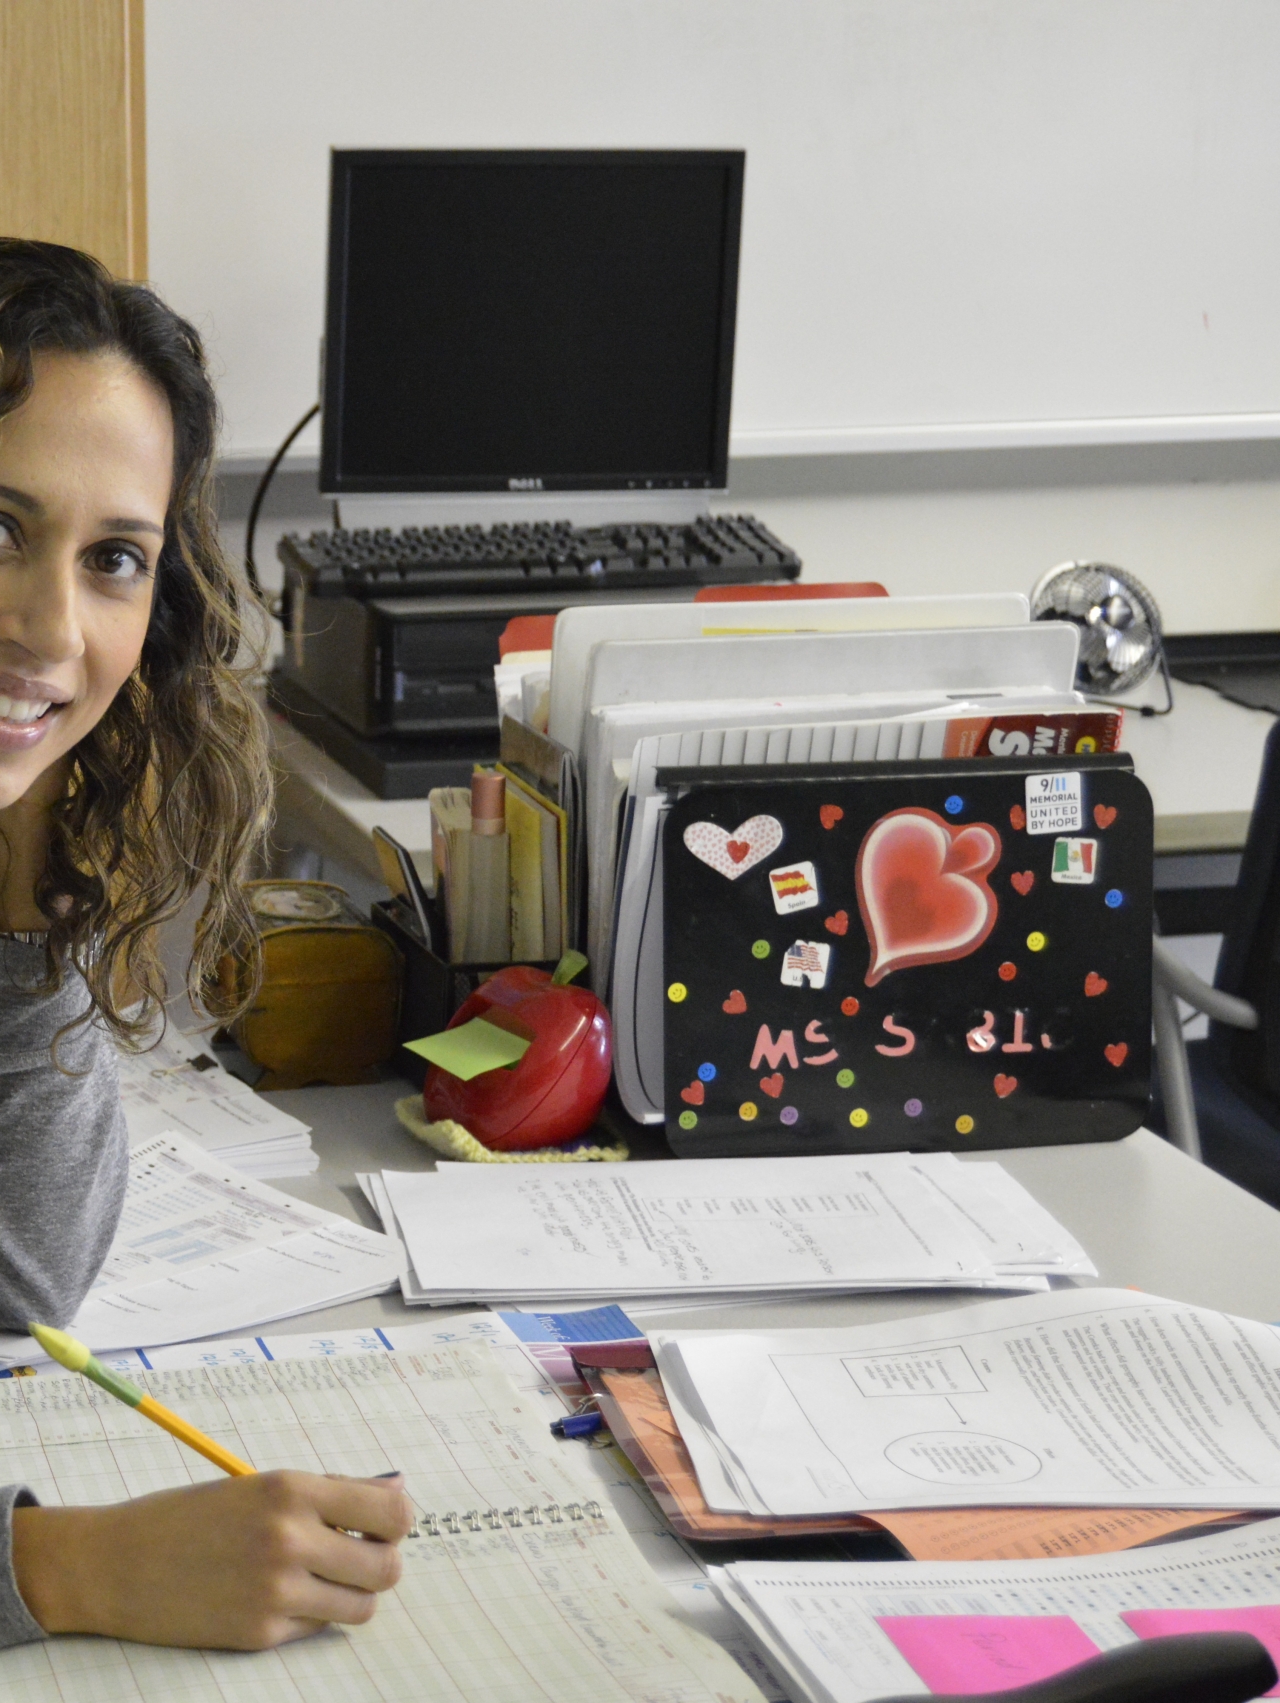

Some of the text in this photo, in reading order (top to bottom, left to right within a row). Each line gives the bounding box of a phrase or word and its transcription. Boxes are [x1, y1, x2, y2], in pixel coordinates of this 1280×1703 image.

[1040, 776, 1066, 793] 9/11
[1029, 793, 1078, 804] MEMORIAL
[1030, 806, 1078, 818] UNITED
[1031, 817, 1078, 830] BY HOPE
